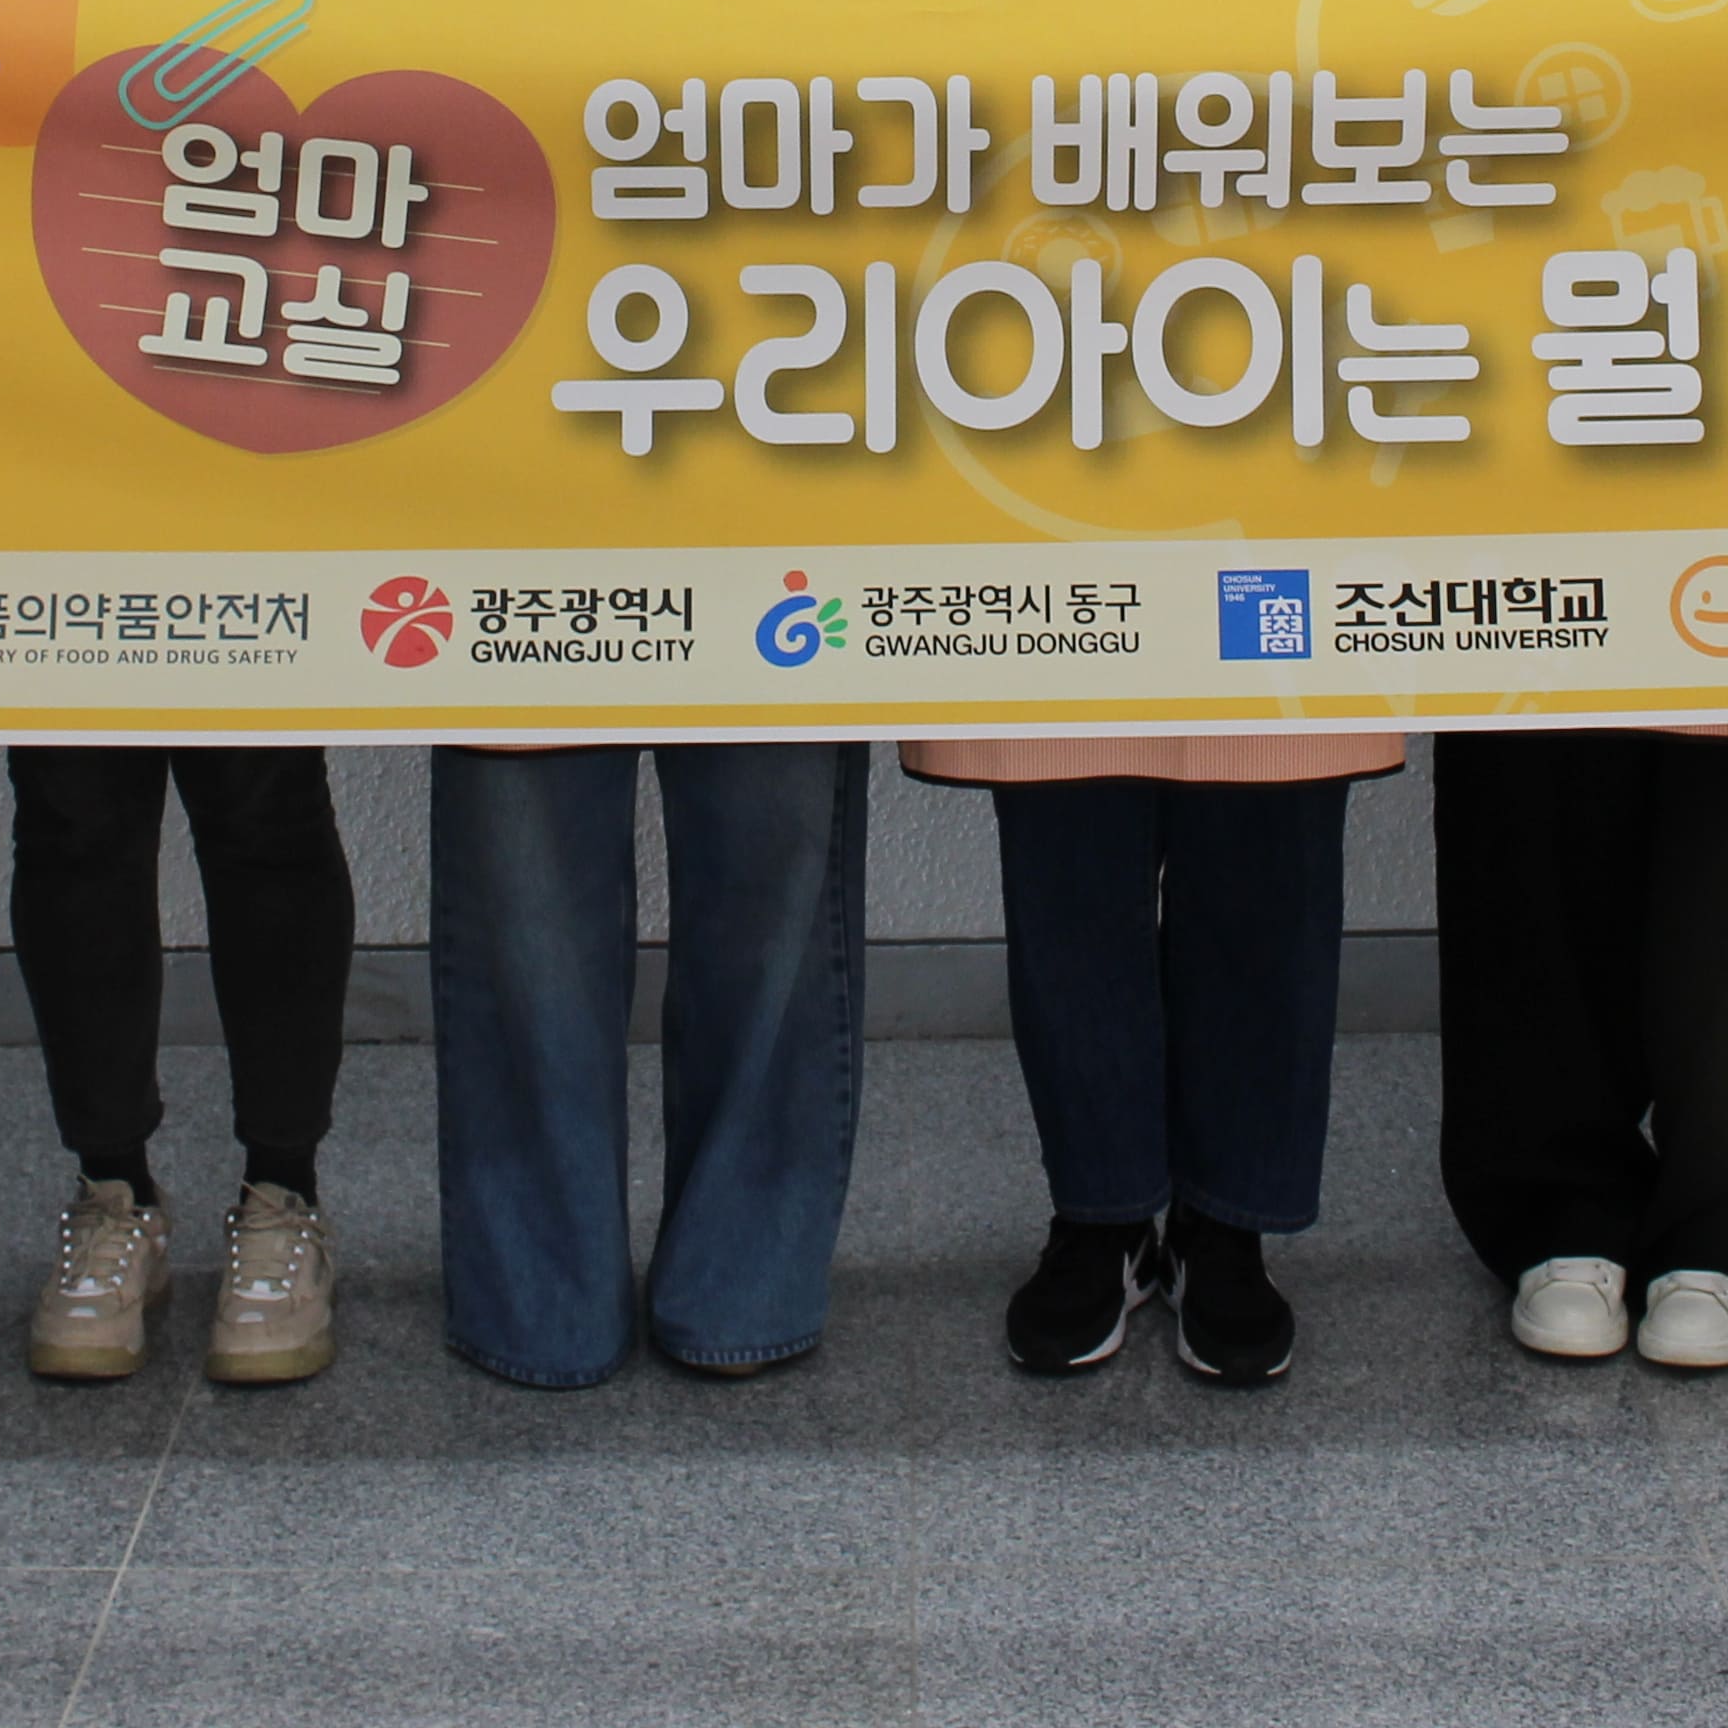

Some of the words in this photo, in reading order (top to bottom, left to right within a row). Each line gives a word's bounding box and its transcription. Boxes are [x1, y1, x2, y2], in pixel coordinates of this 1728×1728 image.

[582, 72, 992, 221] 엄마가
[1029, 67, 1571, 214] 배워보는
[161, 122, 430, 250] 엄마
[137, 247, 411, 386] 교실
[550, 254, 1482, 458] 우리아이는
[1530, 245, 1706, 447] 뭘
[1223, 575, 1263, 583] CHOSUN
[1223, 583, 1276, 593] UNIVERSITY
[470, 586, 694, 635] 광주광역시
[860, 583, 1052, 627] 광주광역시
[1065, 582, 1142, 625] 동구
[1334, 576, 1609, 628] 조선대학교
[24, 649, 49, 665] OF
[56, 649, 110, 665] FOOD
[116, 649, 159, 665] AND
[166, 649, 221, 665] DRUG
[227, 649, 299, 665] SAFETY
[470, 639, 624, 663] GWANGJU
[630, 638, 696, 662] CITY
[864, 633, 1008, 657] GWANGJU
[1016, 631, 1141, 655] DONGGU
[1334, 631, 1445, 653] CHOSUN
[1455, 627, 1610, 651] UNIVERSITY
